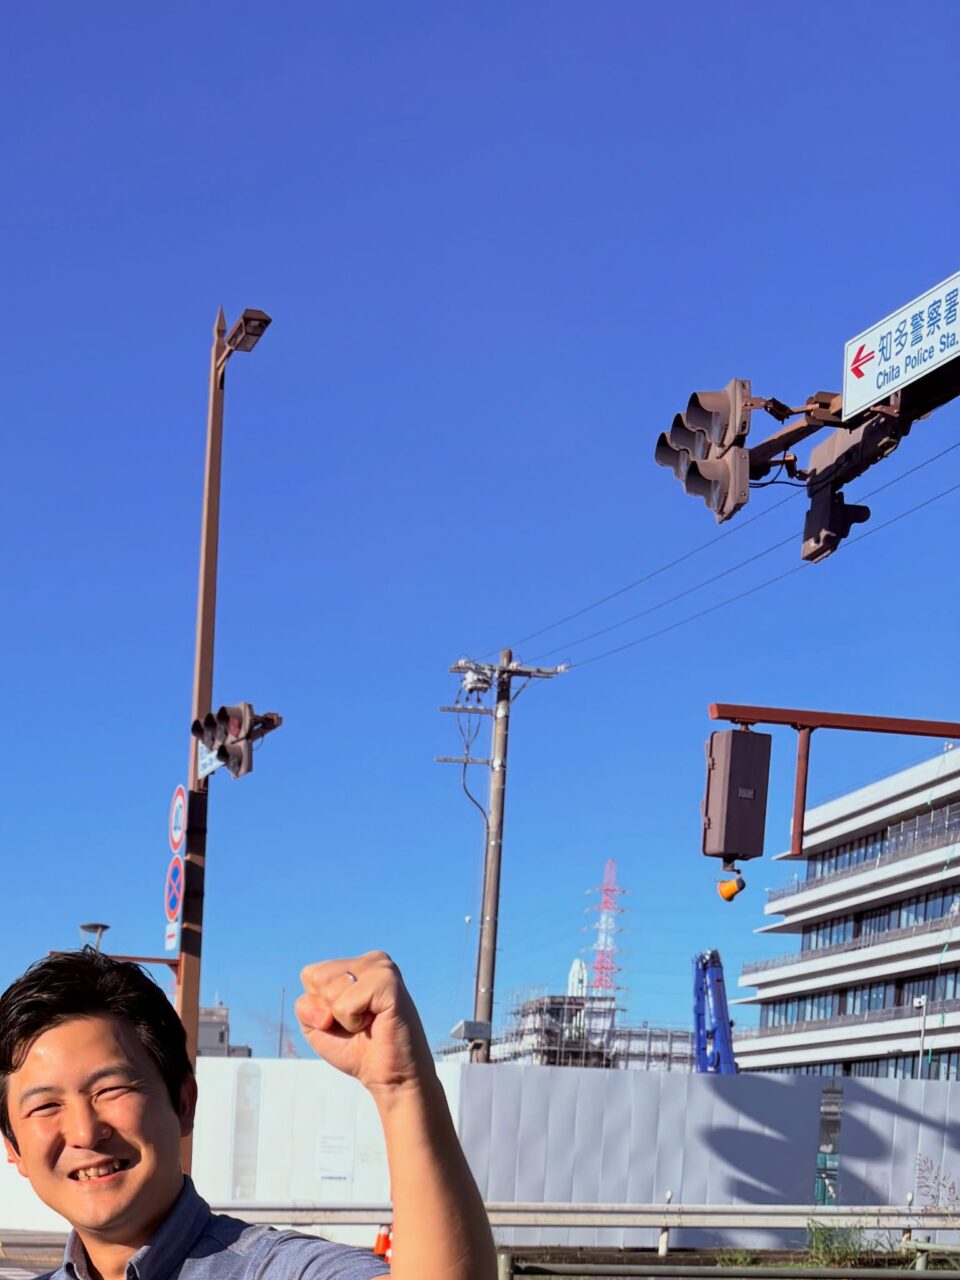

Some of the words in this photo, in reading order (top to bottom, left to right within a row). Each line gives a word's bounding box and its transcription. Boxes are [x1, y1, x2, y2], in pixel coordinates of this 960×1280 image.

[876, 365, 901, 390] Chita
[904, 344, 935, 374] Police
[939, 331, 959, 354] Sta.
[878, 288, 959, 367] 知多警察署
